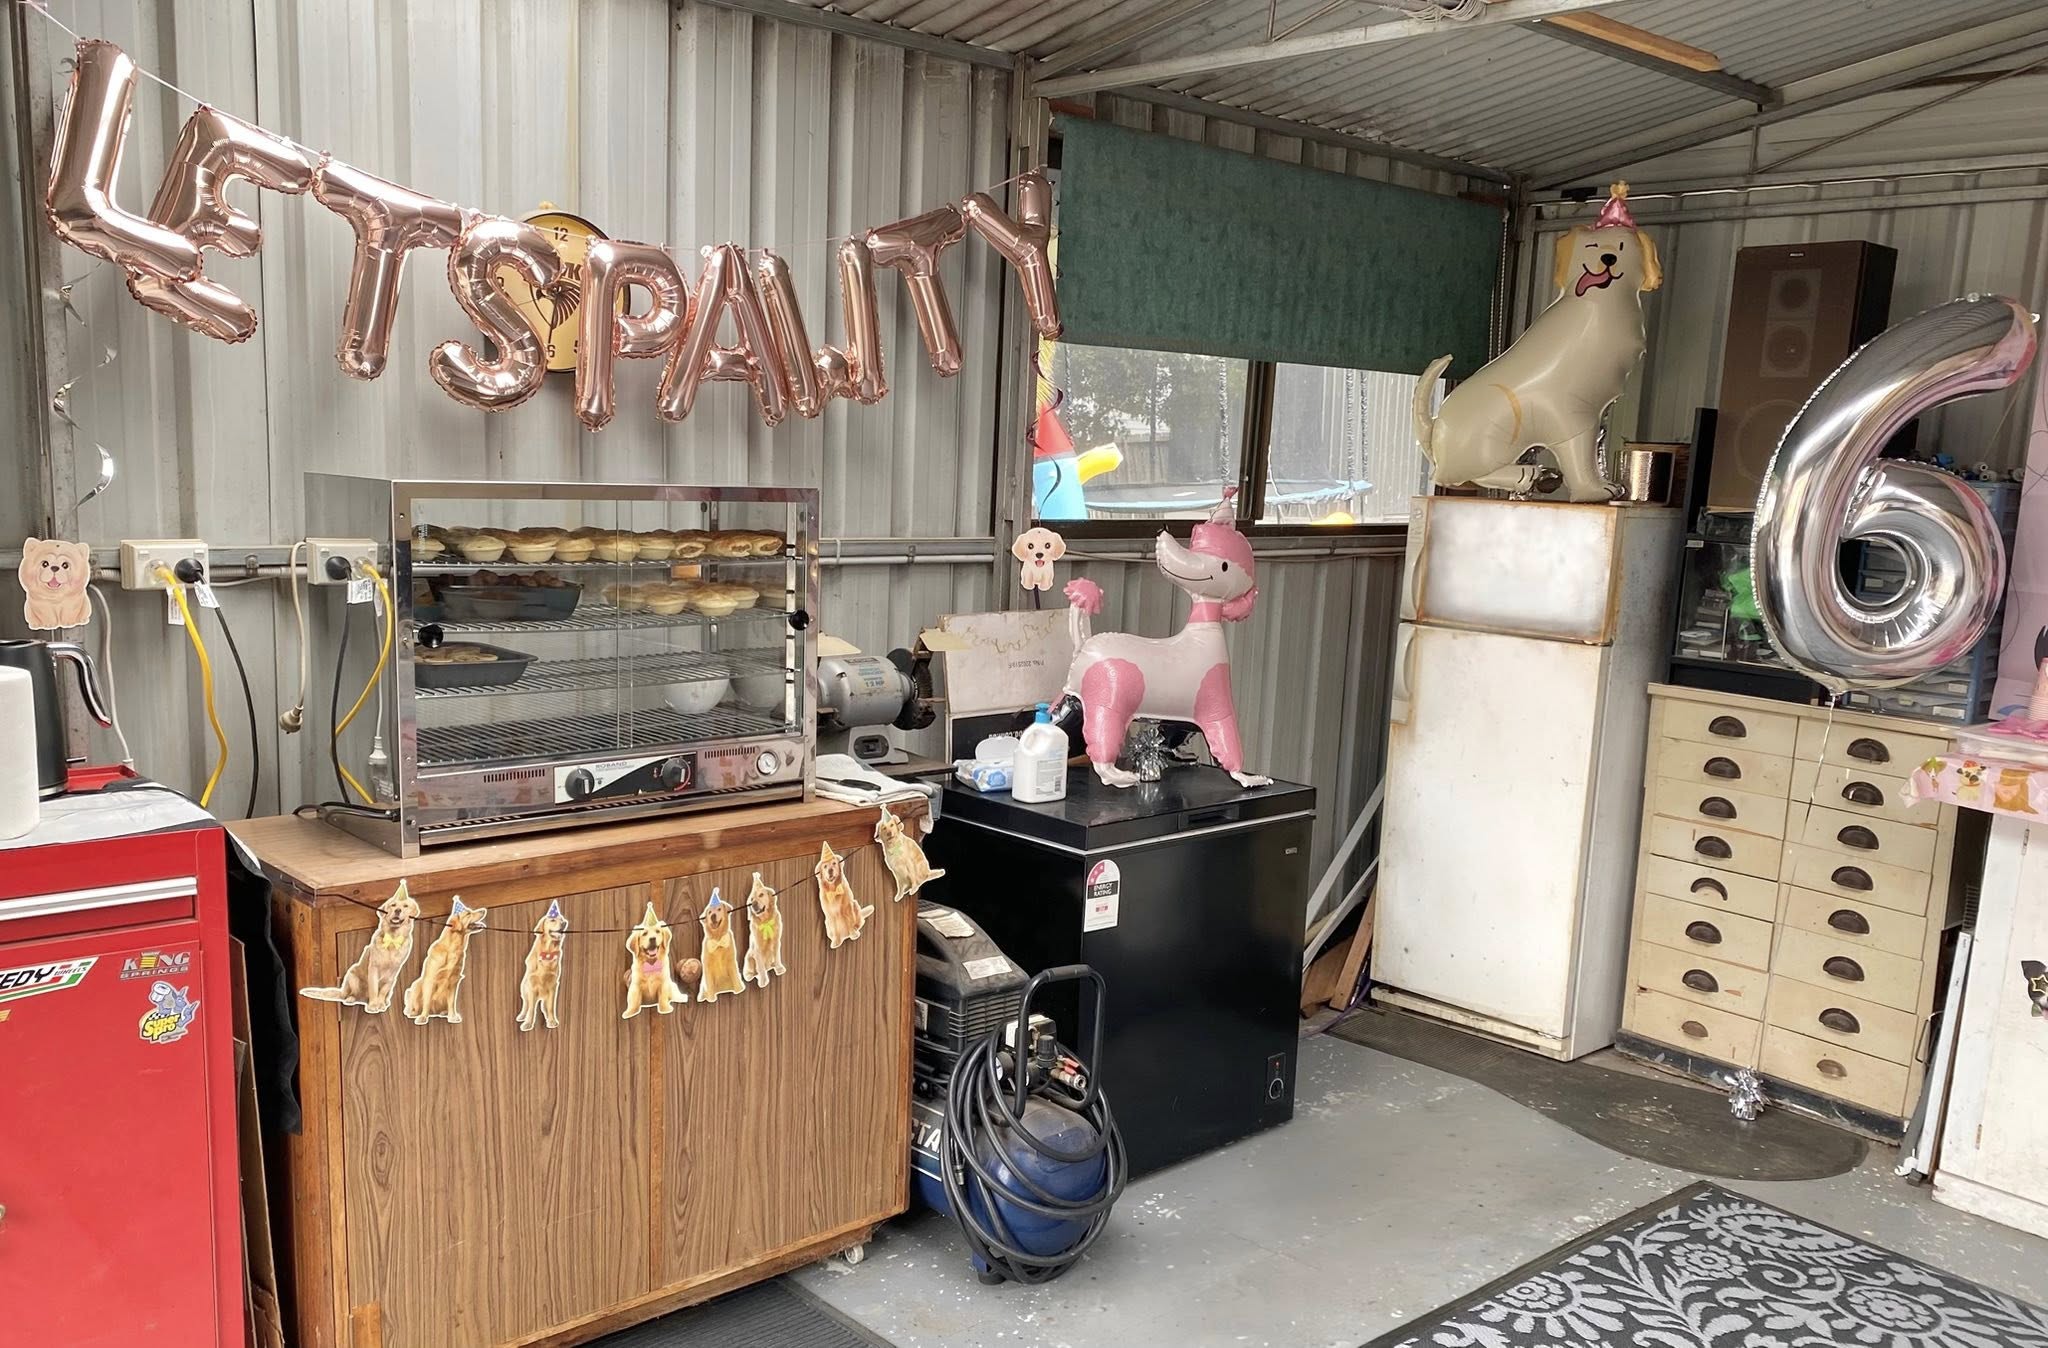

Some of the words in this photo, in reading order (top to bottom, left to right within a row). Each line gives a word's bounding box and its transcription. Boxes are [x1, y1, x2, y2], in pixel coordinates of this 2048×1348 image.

[553, 226, 569, 242] 12
[547, 344, 556, 358] 6
[1751, 294, 2037, 690] 6
[1093, 883, 1113, 891] ENERGY
[1093, 889, 1112, 897] RATING
[54, 966, 87, 976] WHEELS
[120, 966, 189, 979] SPRINGS
